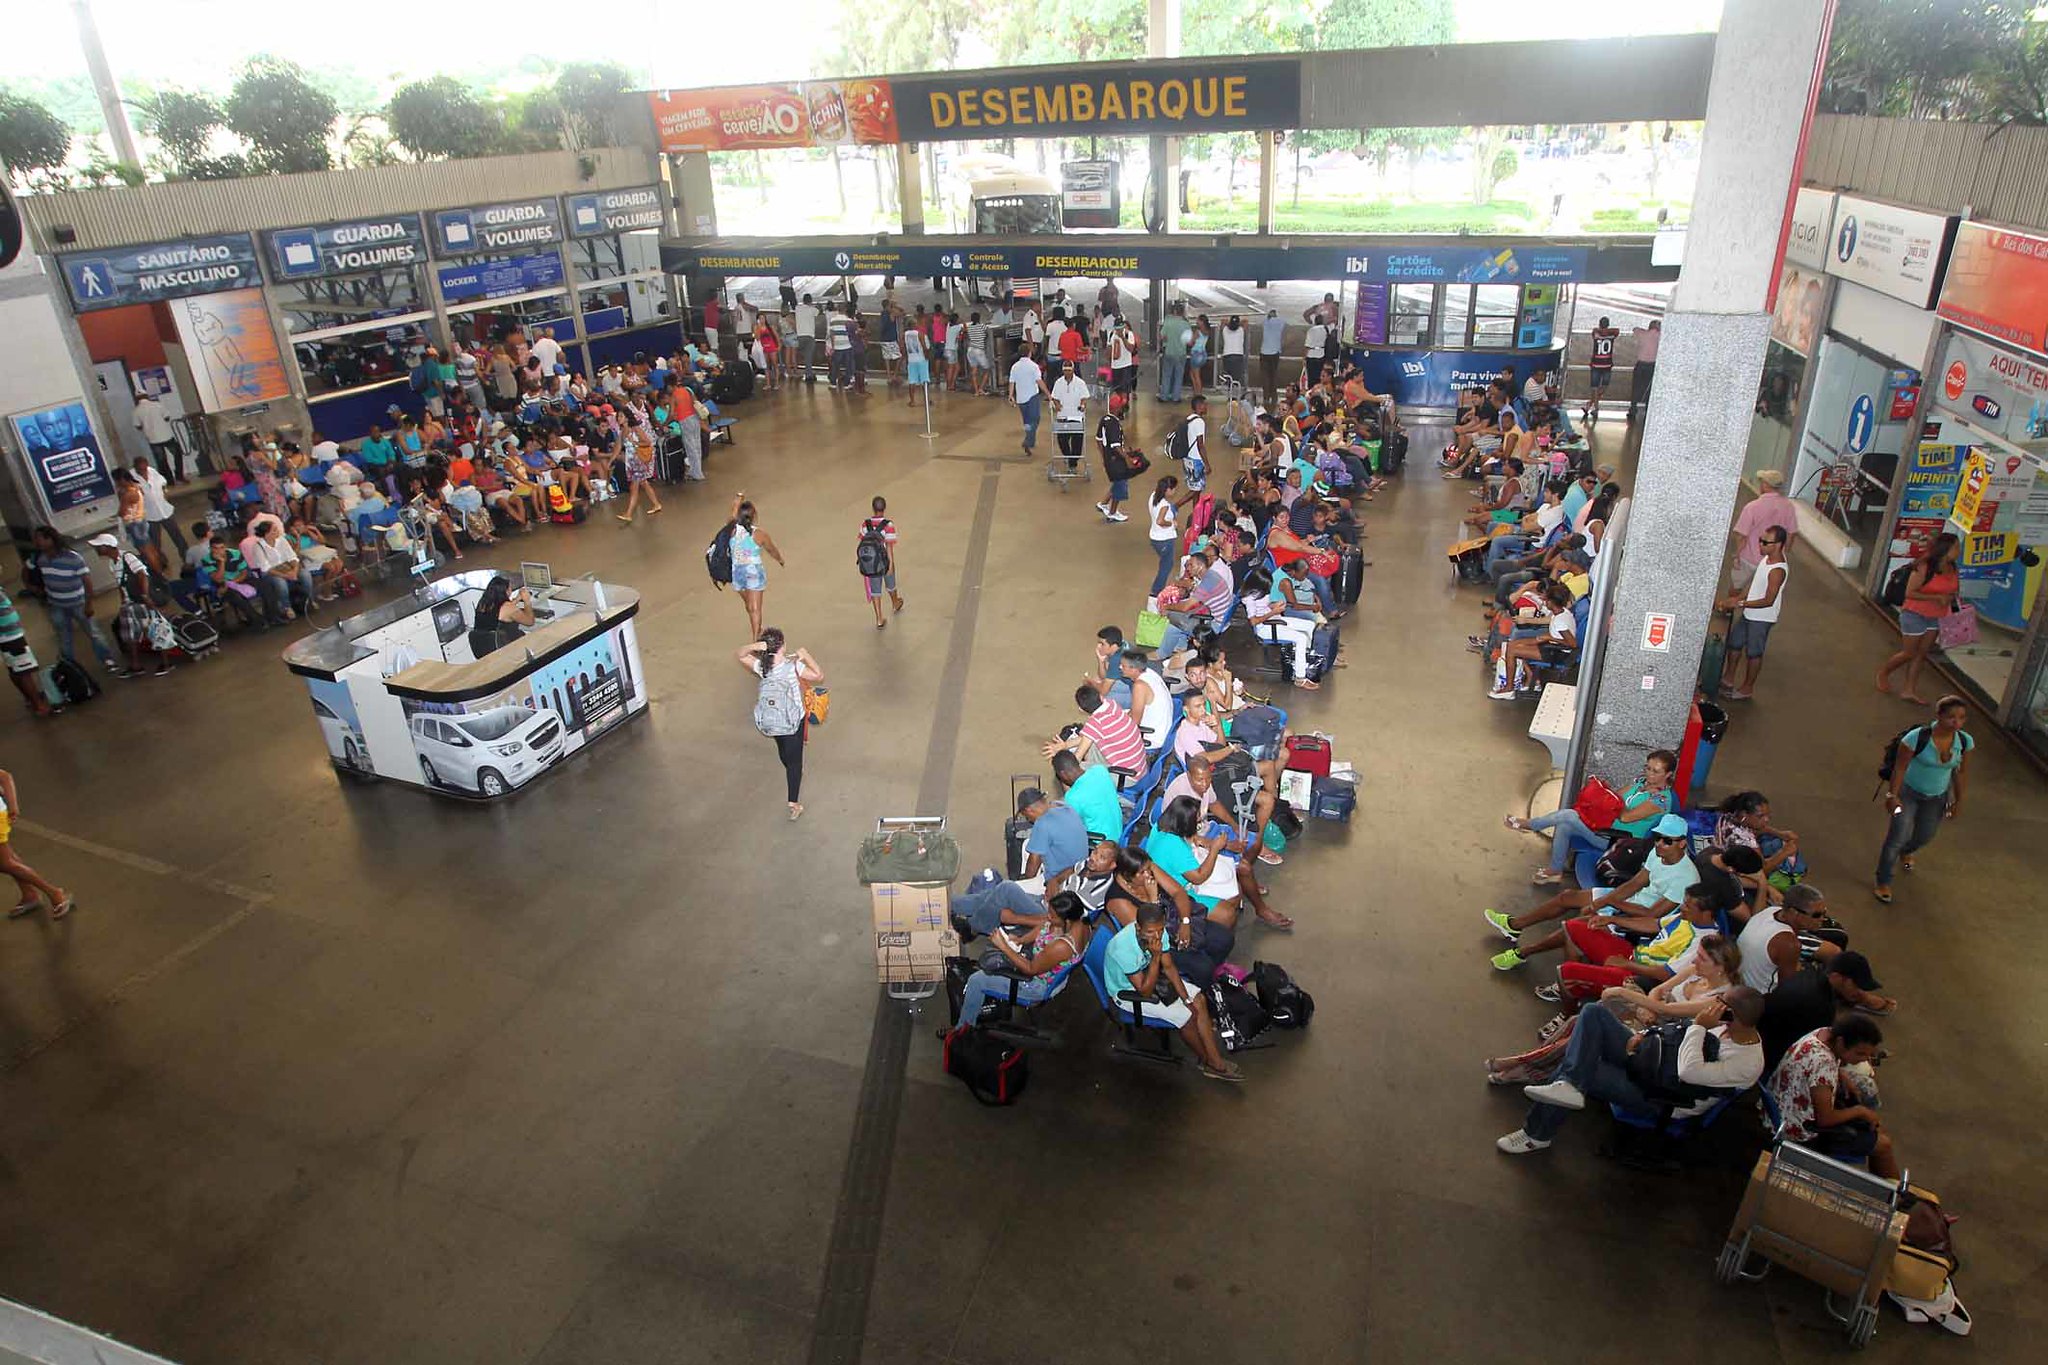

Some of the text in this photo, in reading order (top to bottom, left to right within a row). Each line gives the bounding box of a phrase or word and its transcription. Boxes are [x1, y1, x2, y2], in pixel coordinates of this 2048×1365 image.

[929, 76, 1247, 129] DESEMBARQUE
[606, 192, 657, 208] GUARDA
[485, 205, 546, 224] GUARDA
[606, 210, 663, 229] VOLUMES
[333, 222, 406, 244] GUARDA
[485, 226, 553, 247] VOLUMES
[137, 244, 231, 269] SANITÁRIO
[334, 245, 416, 269] VOLUMES
[700, 256, 781, 269] DESEMBARQUE
[853, 253, 900, 262] Desembarque
[969, 253, 1003, 262] Controle
[1036, 256, 1138, 269] DESEMBARQUE
[1388, 255, 1432, 267] Cartões
[969, 263, 1010, 271] de Acesso
[1346, 256, 1369, 273] ibi
[1387, 266, 1444, 276] de crédito
[139, 265, 240, 291] MASCULINO
[1081, 269, 1123, 277] Controlado
[443, 275, 478, 288] LOCKERS
[1597, 339, 1611, 355] 10
[1402, 361, 1424, 373] ibi
[1989, 354, 2021, 379] AQUI
[1452, 370, 1477, 380] Para
[1985, 401, 1999, 416] TIM
[1920, 451, 1944, 465] TIM
[1973, 534, 2005, 551] TIM
[1972, 550, 2004, 564] CHIP
